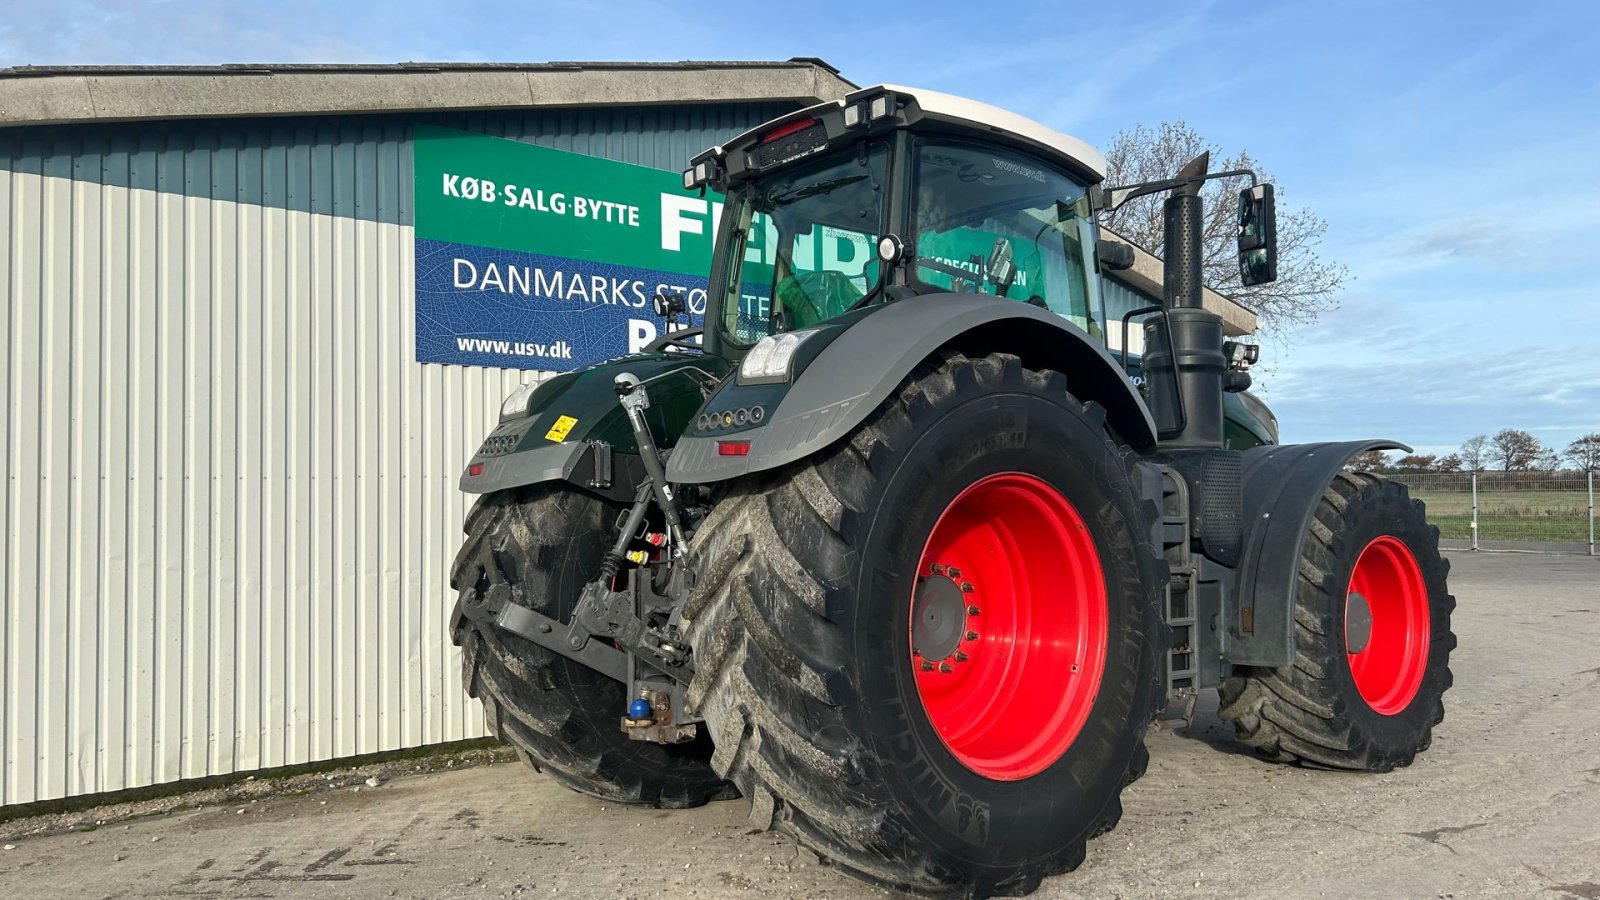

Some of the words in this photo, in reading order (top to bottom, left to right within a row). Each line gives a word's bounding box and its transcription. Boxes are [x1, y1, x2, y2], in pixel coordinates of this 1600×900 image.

[660, 192, 878, 277] FEND
[453, 258, 646, 308] DANMARKS
[457, 337, 572, 359] www.usv.dk
